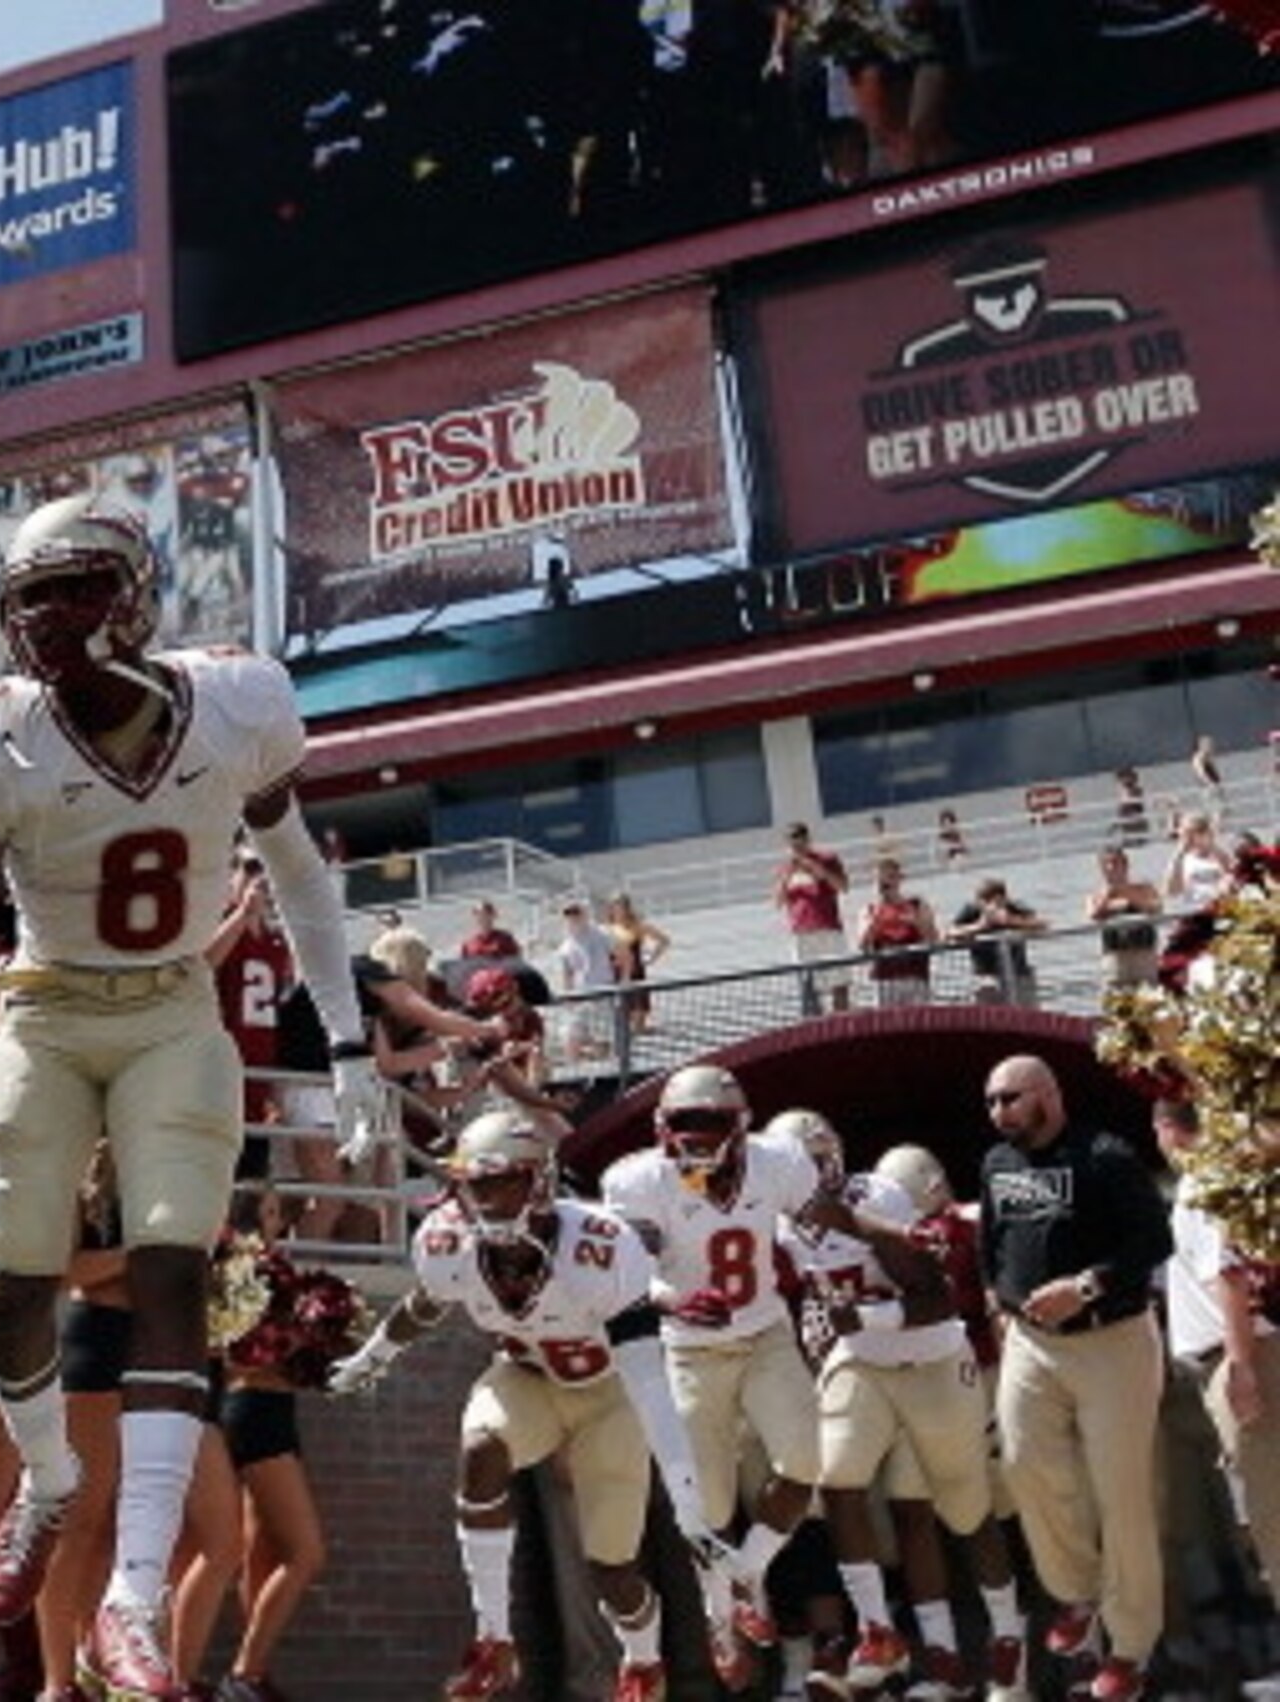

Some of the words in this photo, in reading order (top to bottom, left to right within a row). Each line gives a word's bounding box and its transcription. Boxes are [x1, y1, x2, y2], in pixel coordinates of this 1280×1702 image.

[872, 146, 1094, 215] DAKTRONICS
[863, 375, 970, 432] DRIVE
[984, 342, 1117, 406] SOBER
[1128, 329, 1188, 375] OR
[868, 426, 934, 478] GET
[943, 395, 1084, 463] PULLED
[1093, 373, 1200, 432] OVER
[376, 487, 504, 555] Credit
[507, 463, 639, 521] Union
[97, 827, 190, 952] 8
[573, 1214, 619, 1271] 26
[708, 1228, 758, 1310] 8
